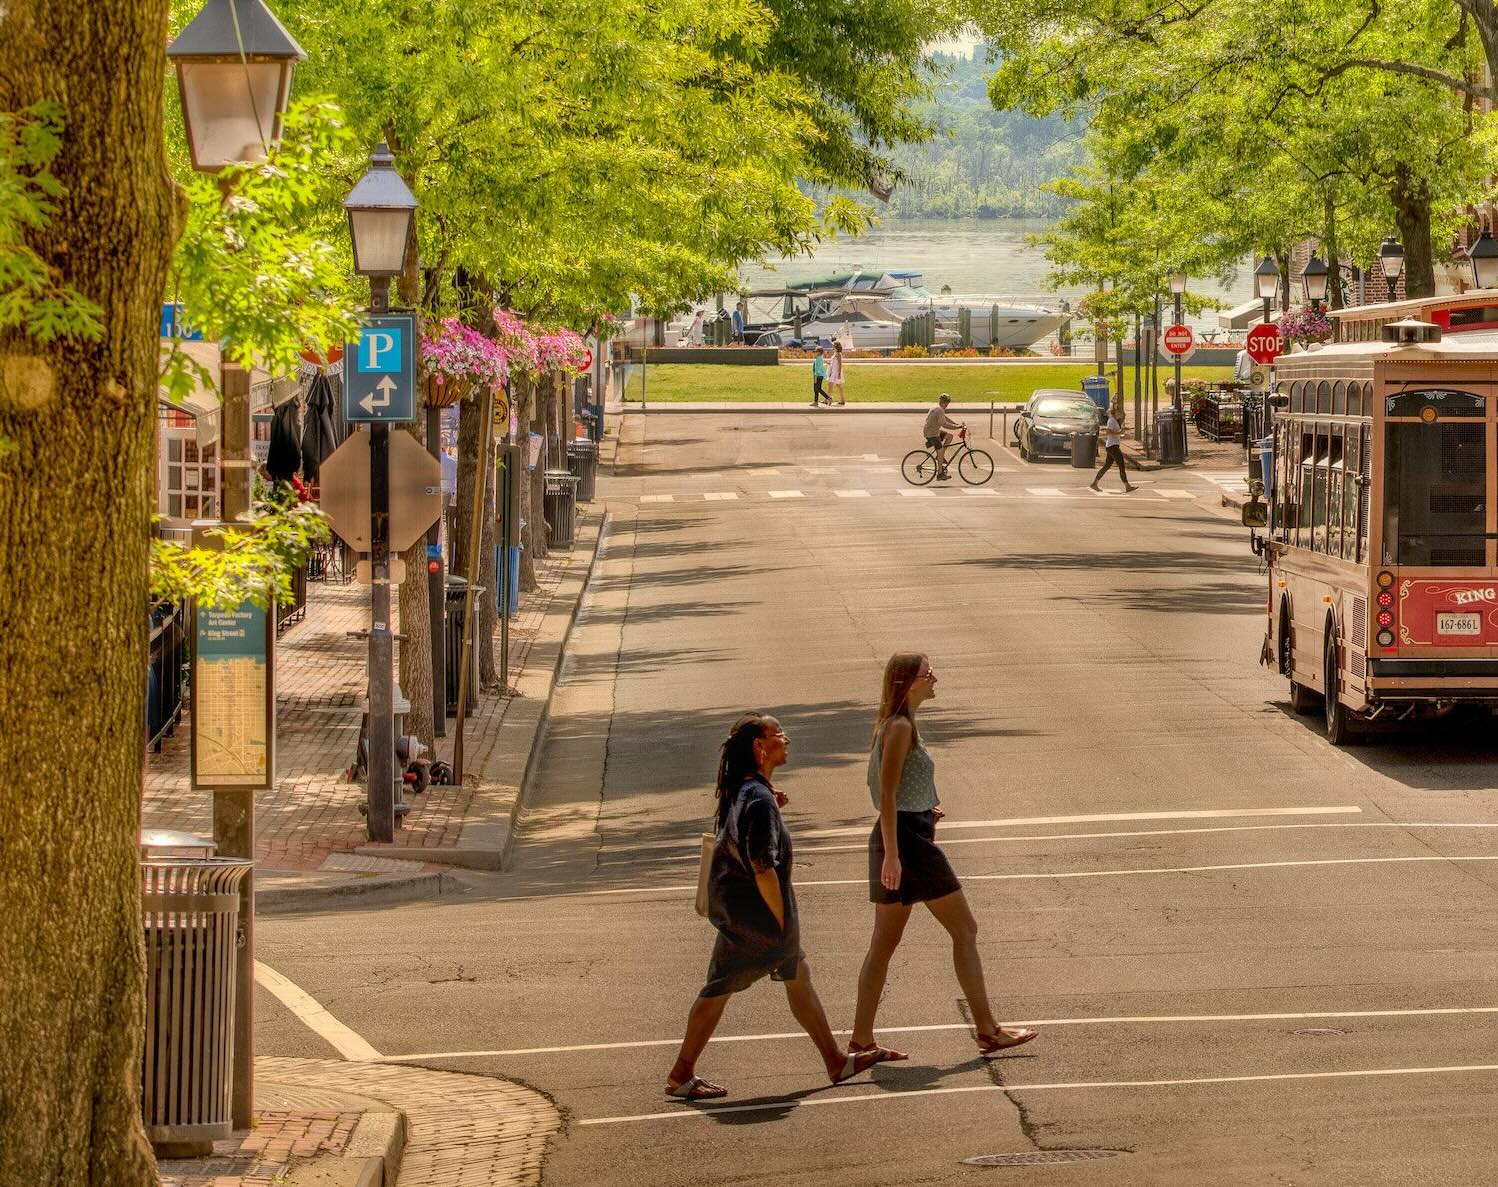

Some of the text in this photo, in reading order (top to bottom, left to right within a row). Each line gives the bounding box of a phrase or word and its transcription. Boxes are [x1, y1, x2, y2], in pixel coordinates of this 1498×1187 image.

[365, 333, 394, 369] P
[1249, 337, 1283, 352] STOP
[1455, 588, 1496, 605] KING
